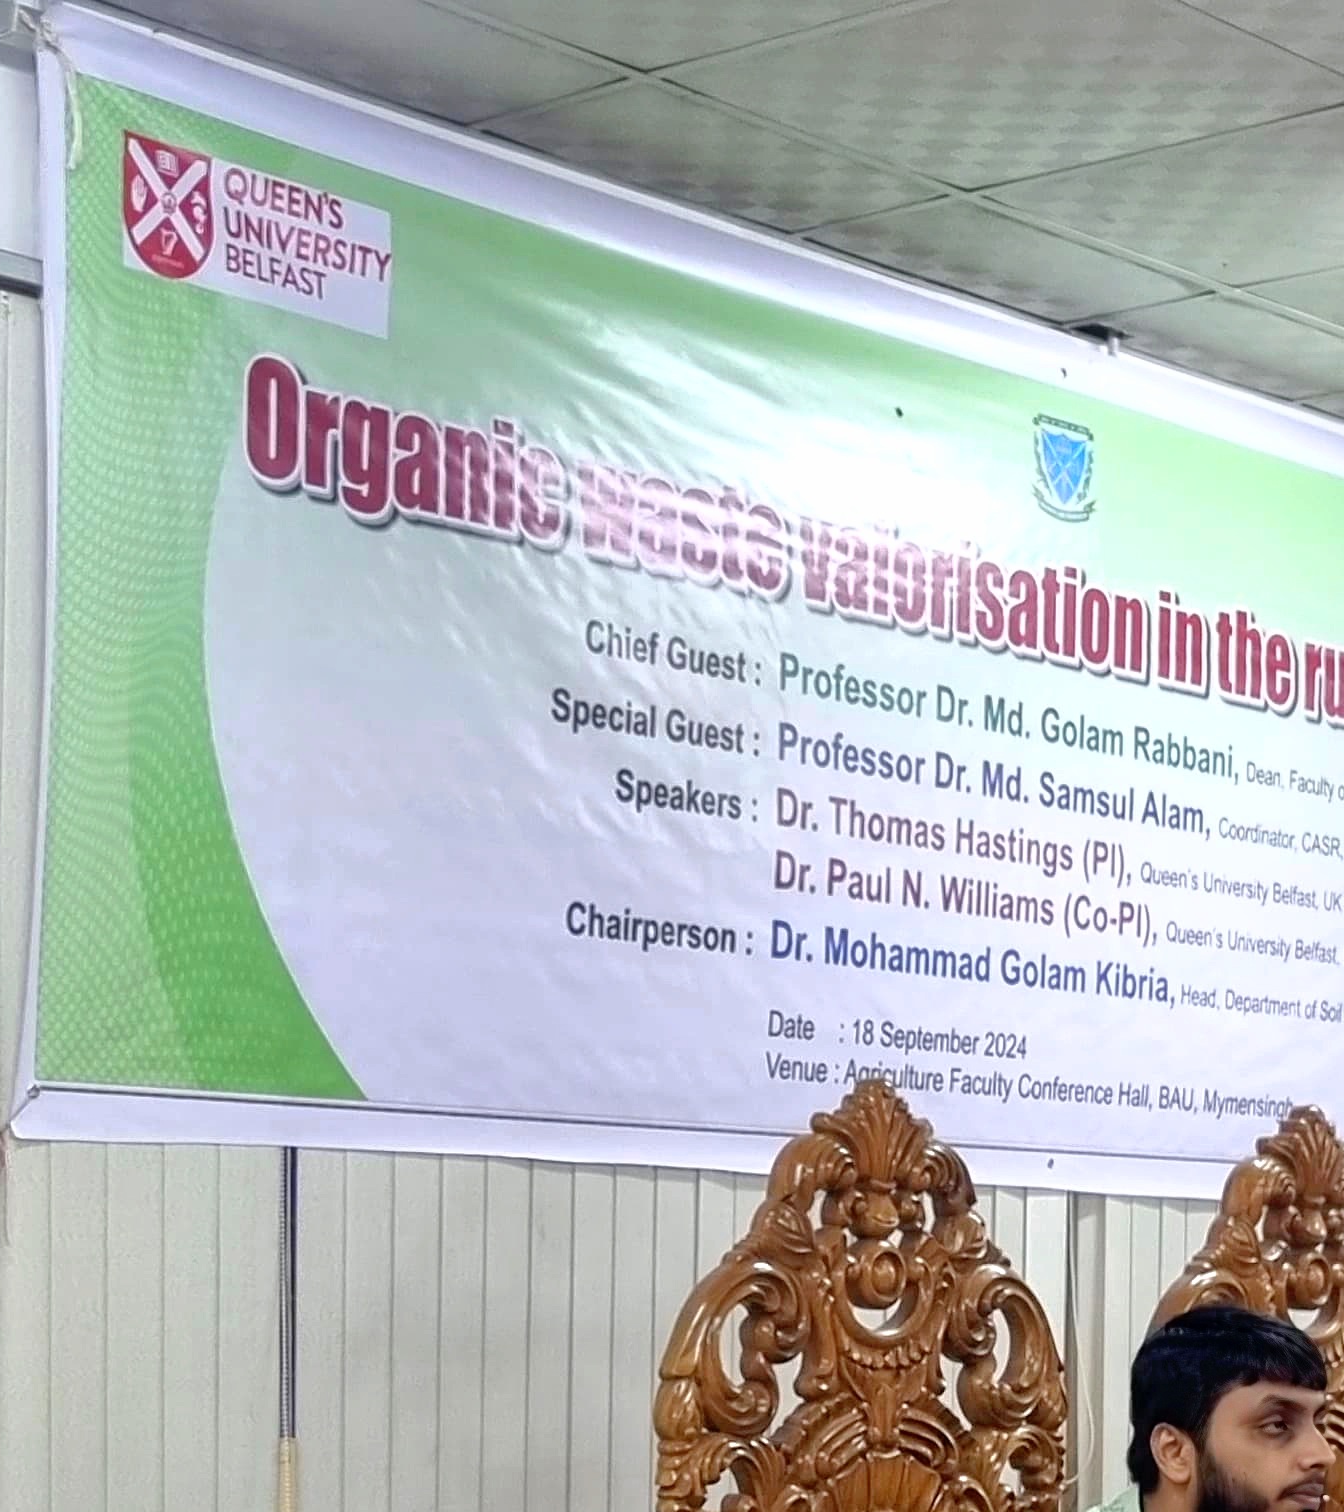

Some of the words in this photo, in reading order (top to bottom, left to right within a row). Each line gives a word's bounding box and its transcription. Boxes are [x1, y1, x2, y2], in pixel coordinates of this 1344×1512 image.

[223, 167, 344, 230] QUEEN'S
[223, 206, 392, 283] UNIVERSITY
[225, 243, 327, 301] BELFAST
[246, 353, 564, 546] Organic
[800, 514, 1148, 678] valorisation
[1159, 591, 1208, 694] in
[1216, 609, 1296, 709] the
[586, 619, 659, 664] Chief
[666, 637, 746, 683] Guest
[780, 653, 926, 717] Professor
[937, 685, 973, 728] Dr.
[984, 695, 1030, 738] Md.
[1041, 707, 1123, 756] Golam
[1134, 727, 1239, 784] Rabbani,
[1290, 771, 1333, 802] Faculty
[551, 688, 656, 738] Special
[666, 709, 744, 753] Guest
[778, 723, 925, 784] Professor
[935, 752, 971, 793] Dr.
[982, 761, 1028, 803] Md.
[1039, 771, 1134, 822] Samsul
[1142, 791, 1211, 840] Alam,
[1301, 831, 1344, 861] CASR,
[616, 769, 741, 820] Speakers
[777, 788, 818, 831] Dr.
[830, 796, 945, 852] Thomas
[956, 817, 1073, 877] Hastings
[1083, 838, 1132, 888] (PI),
[1141, 862, 1198, 890] Queen's
[1203, 871, 1268, 906] University
[1324, 892, 1342, 912] UK
[774, 850, 815, 894] Dr.
[827, 858, 891, 905] Paul
[902, 869, 929, 911] N.
[940, 875, 1054, 925] Williams
[1064, 892, 1158, 947] (Co-PI),
[1165, 921, 1224, 949] Queen's
[1228, 931, 1291, 961] University
[566, 901, 736, 953] Chairperson
[771, 920, 813, 962] Dr.
[824, 926, 991, 983] Mohammad
[1001, 949, 1086, 993] Golam
[1096, 960, 1176, 1008] Kibria,
[1225, 990, 1301, 1020] Department
[1304, 1001, 1317, 1018] of
[1320, 1001, 1342, 1023] Soil
[765, 1052, 828, 1083] Venue
[950, 1067, 1013, 1103] Faculty
[1018, 1074, 1113, 1106] Conference
[1118, 1083, 1153, 1112] Hall,
[1158, 1086, 1198, 1115] BAU,
[768, 1010, 815, 1042] Date
[853, 1020, 874, 1046] 18
[880, 1022, 979, 1056] September
[984, 1032, 1027, 1060] 2024
